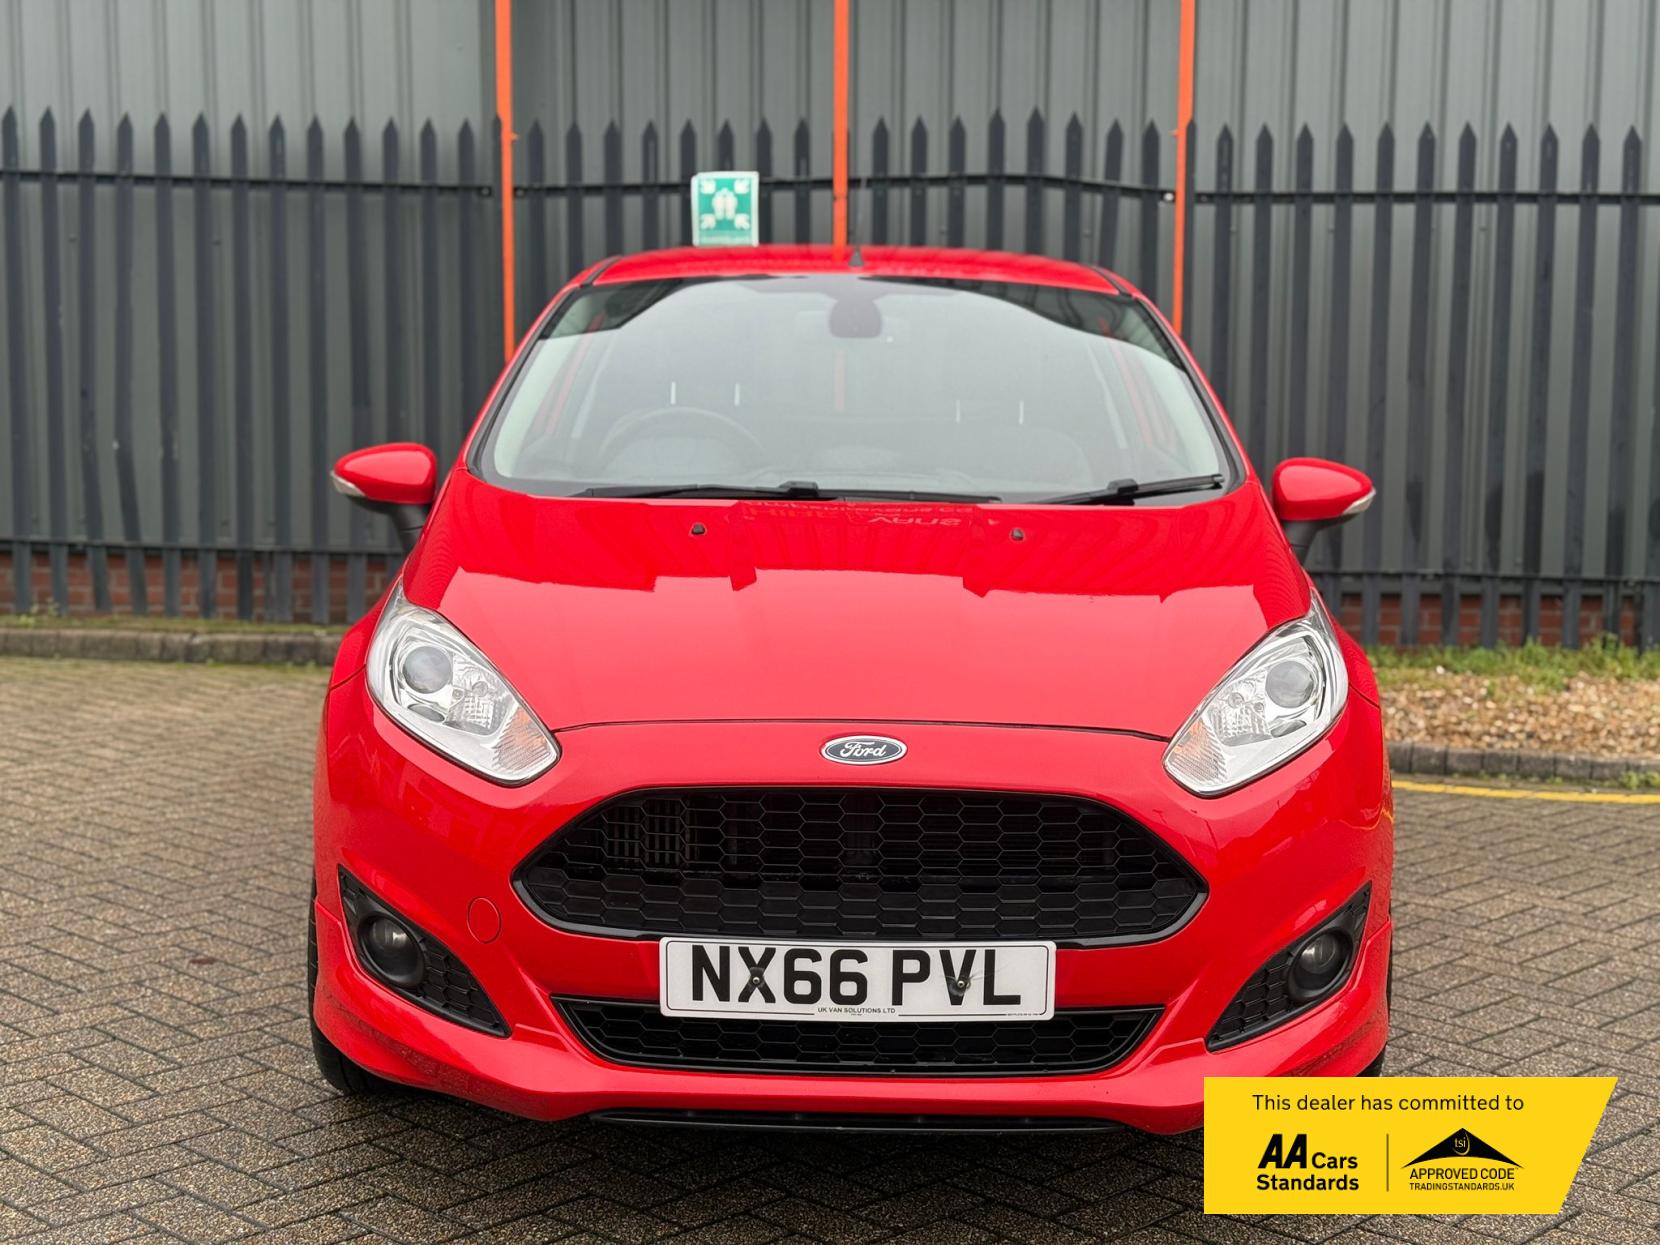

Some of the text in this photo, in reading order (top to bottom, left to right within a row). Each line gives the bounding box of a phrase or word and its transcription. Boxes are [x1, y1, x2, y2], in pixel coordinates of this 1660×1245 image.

[839, 741, 887, 757] Ford
[691, 944, 1022, 1006] NX66 PVL
